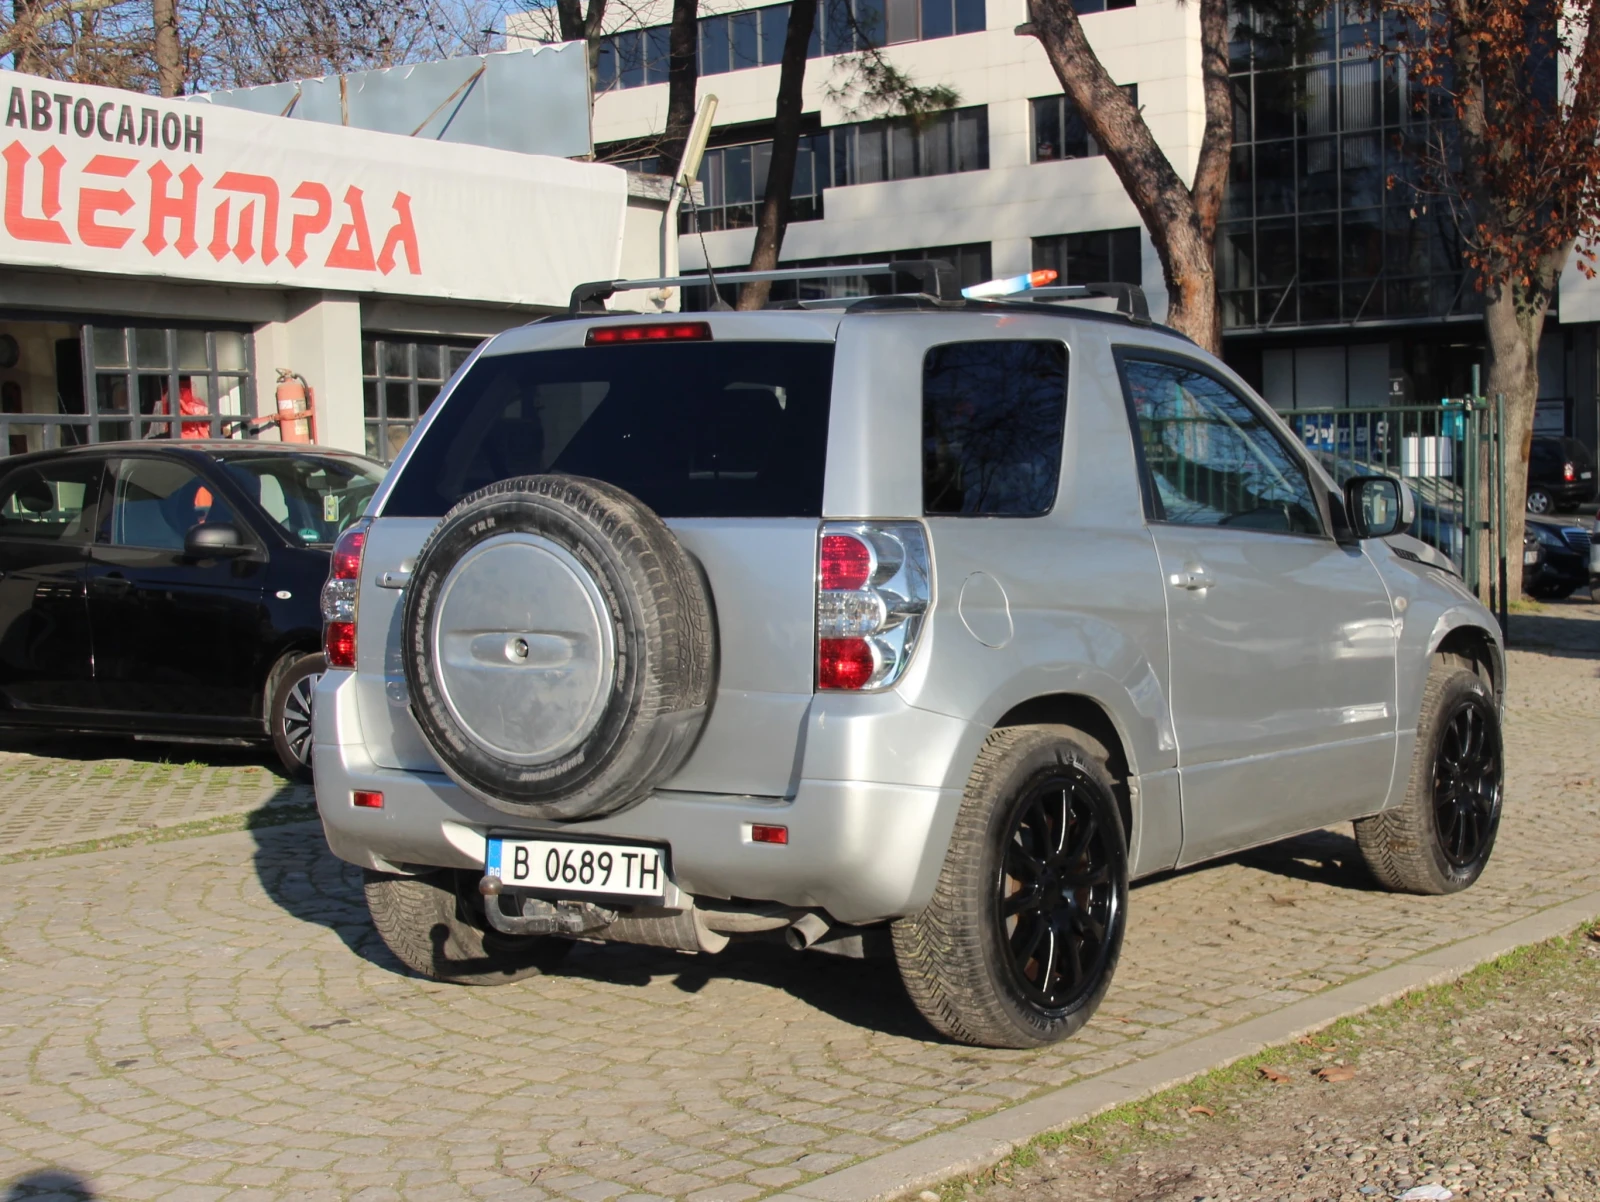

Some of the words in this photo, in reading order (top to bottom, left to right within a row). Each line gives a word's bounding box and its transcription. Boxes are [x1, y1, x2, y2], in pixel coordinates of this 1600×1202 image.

[5, 86, 204, 154] АВТОСАЛОН
[2, 138, 422, 276] ЦЕНТРАЛ
[514, 846, 529, 880] B
[546, 848, 613, 886] 0689
[621, 852, 659, 890] TH
